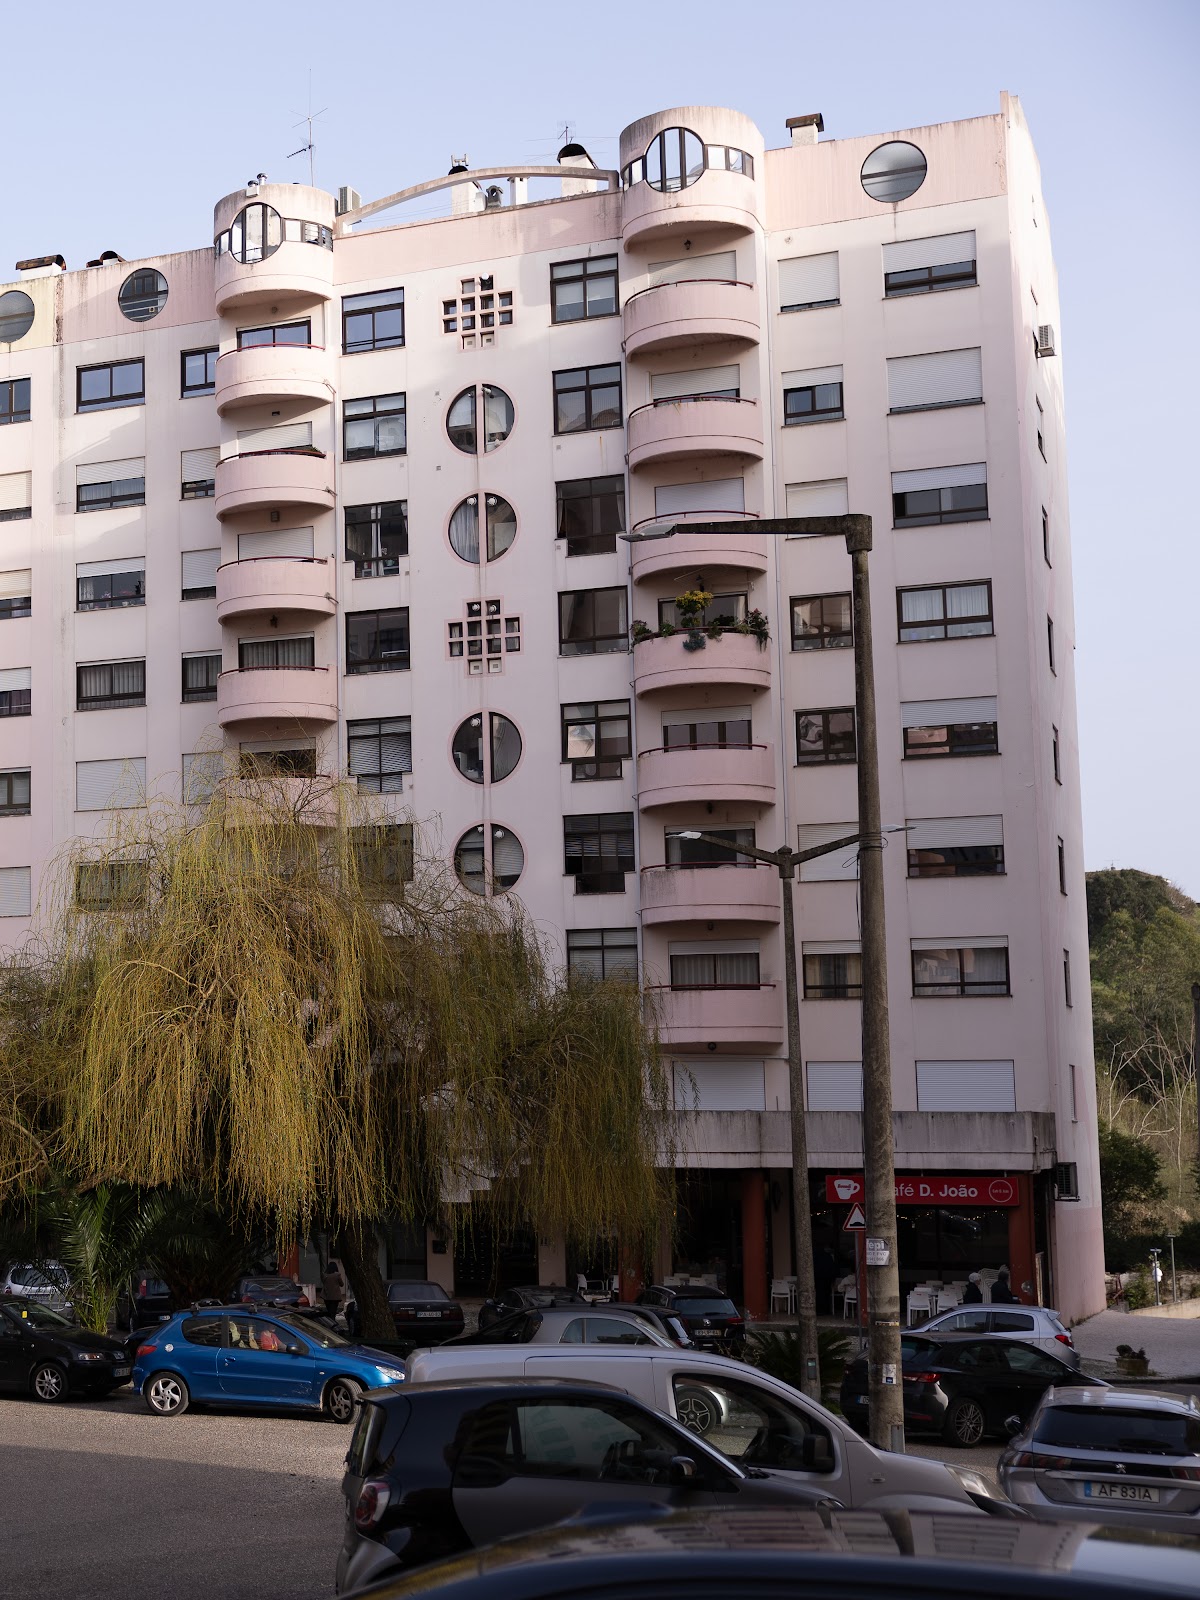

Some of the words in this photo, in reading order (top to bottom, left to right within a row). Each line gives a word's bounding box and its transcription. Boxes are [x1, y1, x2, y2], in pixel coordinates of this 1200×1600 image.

[894, 1183, 914, 1197] afé
[919, 1183, 934, 1197] D.
[939, 1183, 978, 1197] João
